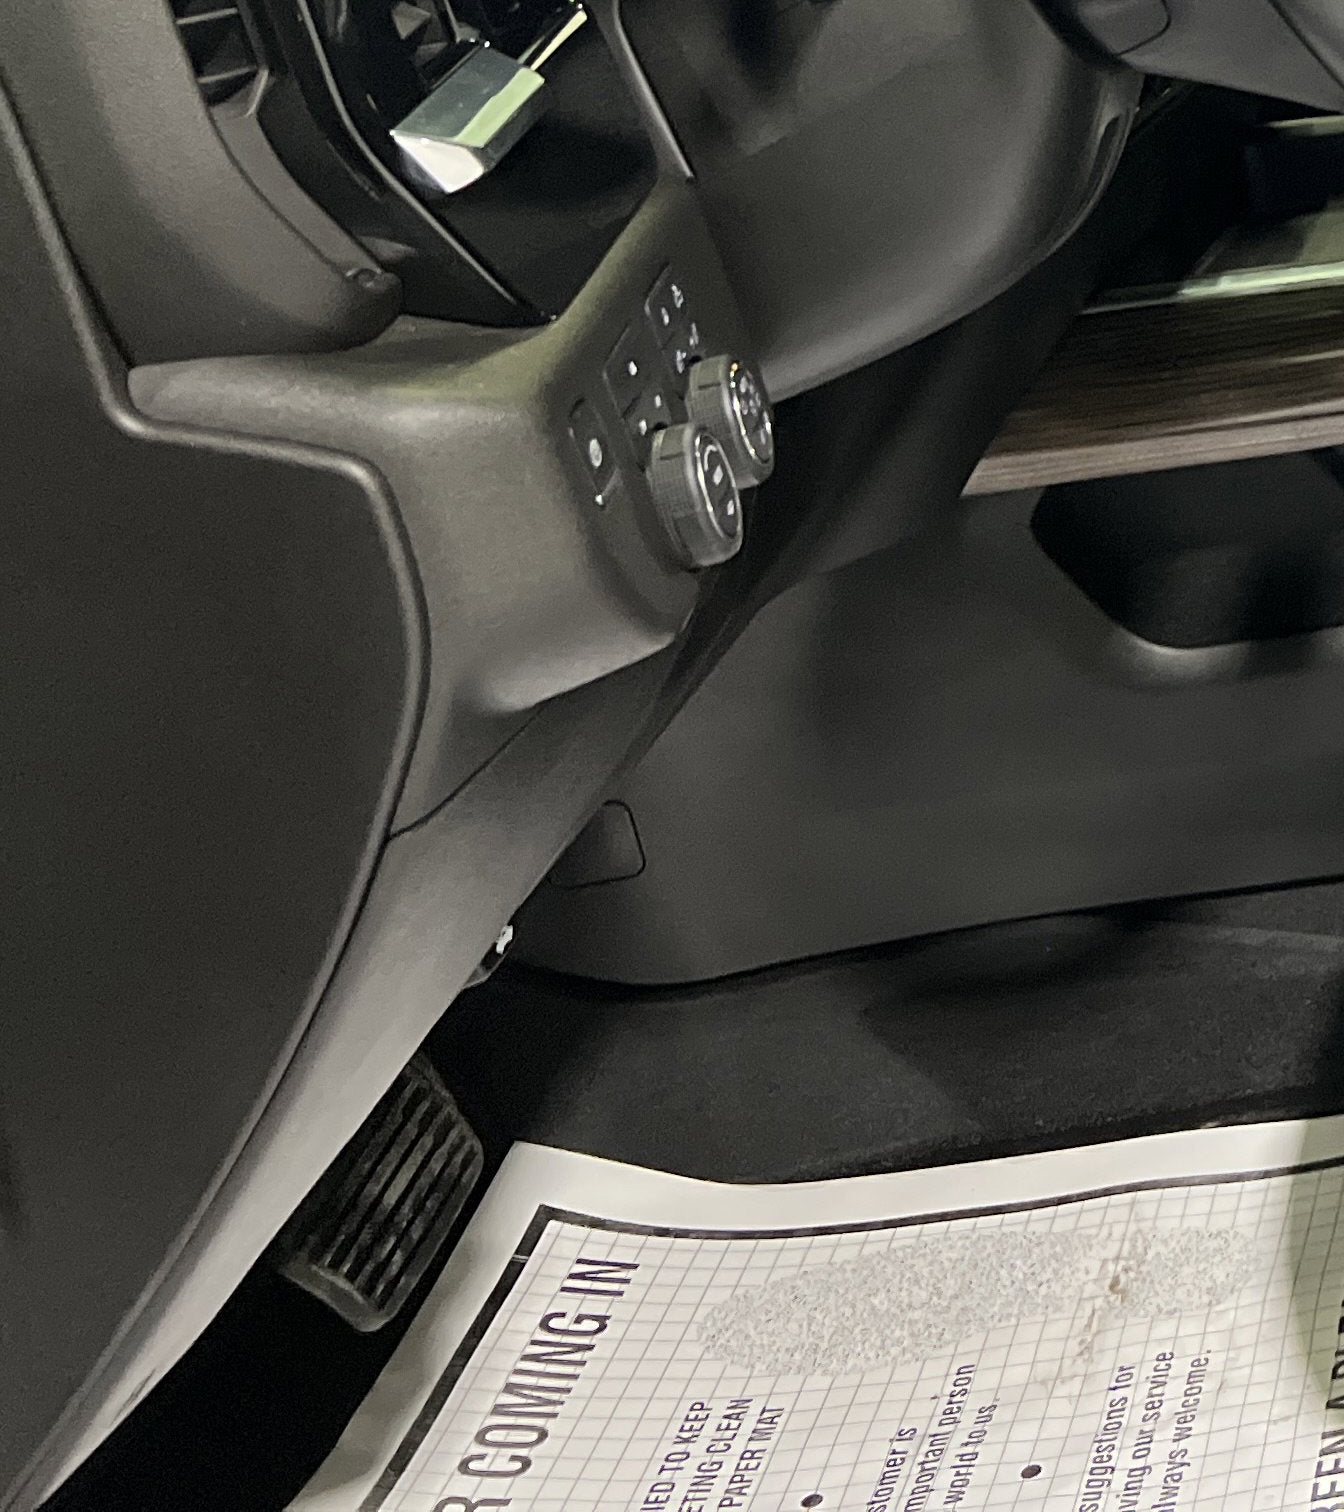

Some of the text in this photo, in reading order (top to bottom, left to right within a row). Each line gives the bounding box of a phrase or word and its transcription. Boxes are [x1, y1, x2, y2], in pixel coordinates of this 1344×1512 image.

[458, 1312, 612, 1478] COMING
[560, 1258, 640, 1297] IN
[938, 1364, 976, 1429] person
[1172, 1349, 1212, 1443] welcome.
[673, 1401, 713, 1445] KEEP
[706, 1398, 753, 1454] CLEAN
[889, 1427, 918, 1443] is
[960, 1429, 987, 1447] to
[1079, 1365, 1136, 1512] suggestions for
[1115, 1351, 1174, 1512] ving our service
[658, 1451, 690, 1475] TO
[718, 1406, 785, 1508] PAPER MAT
[943, 1451, 979, 1505] world
